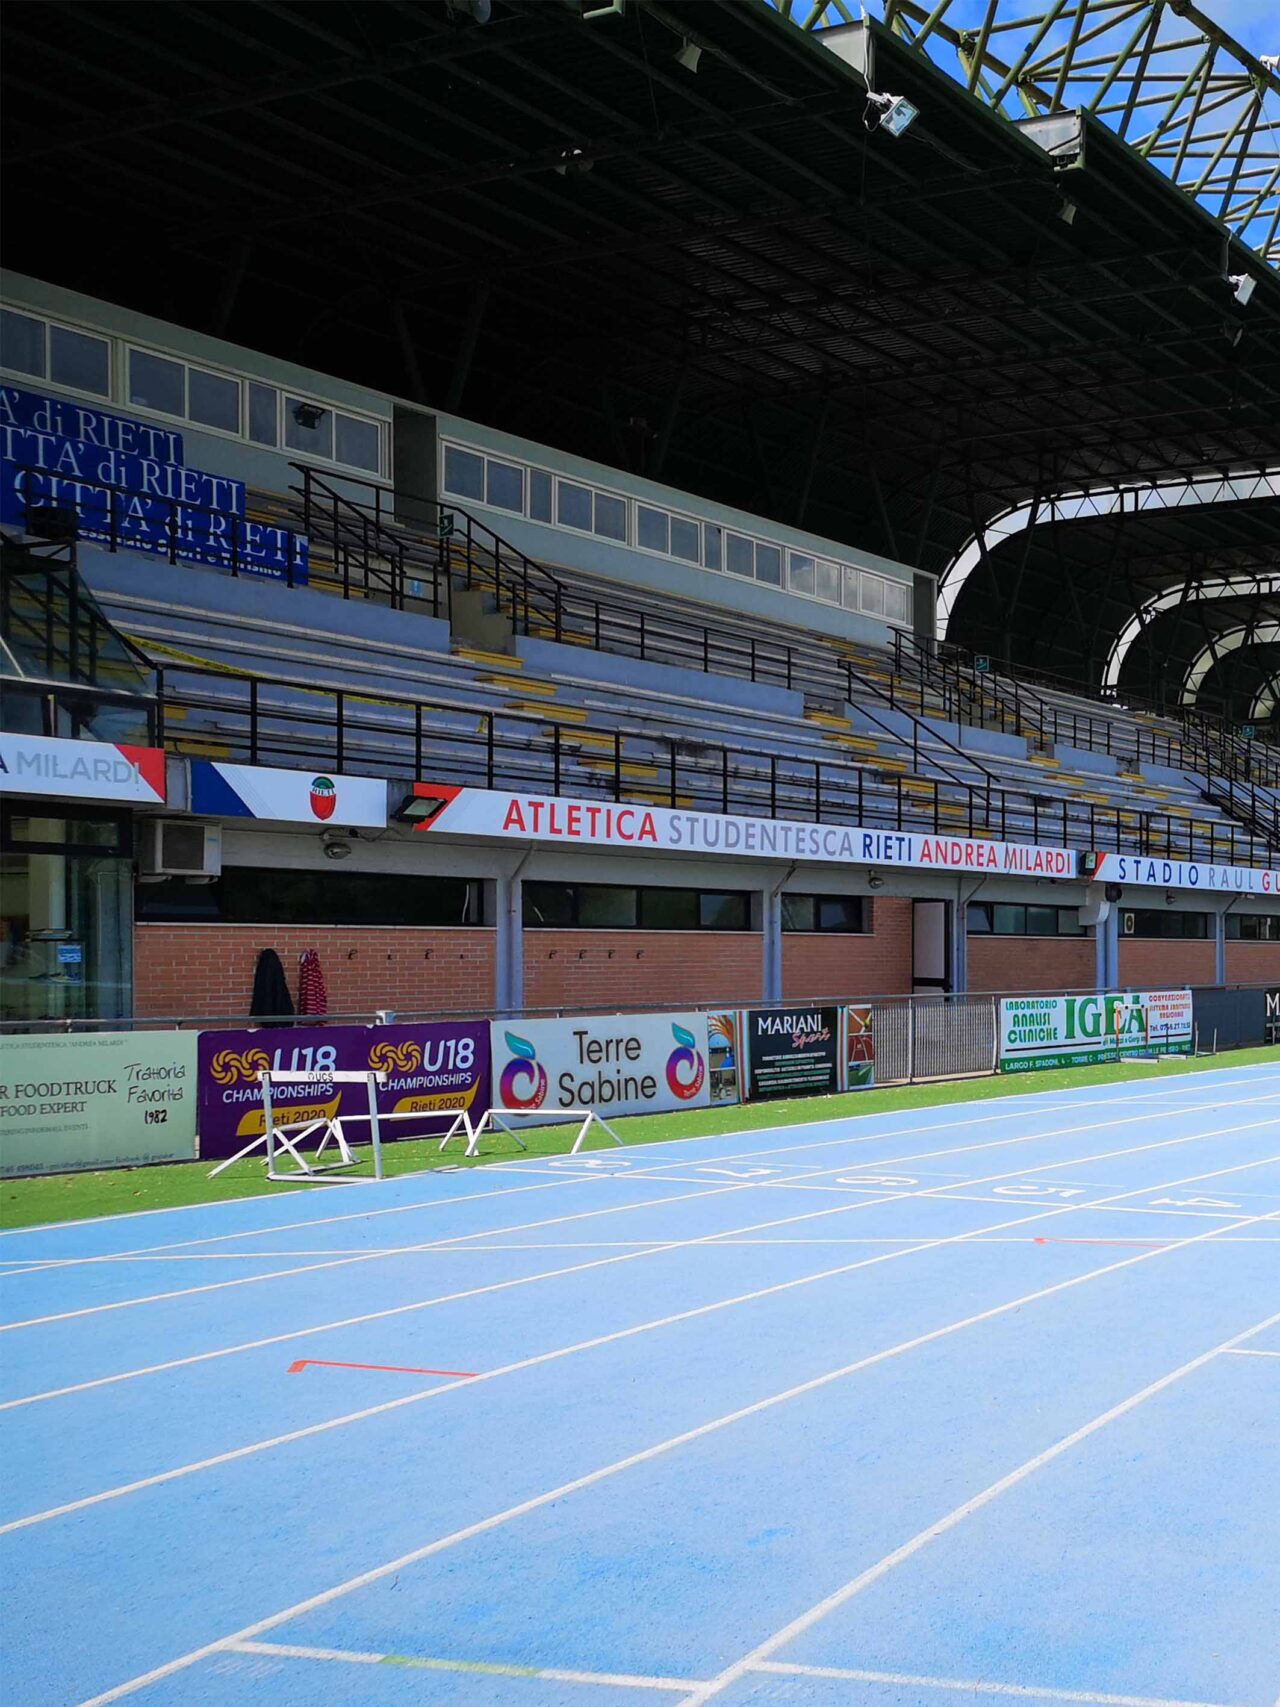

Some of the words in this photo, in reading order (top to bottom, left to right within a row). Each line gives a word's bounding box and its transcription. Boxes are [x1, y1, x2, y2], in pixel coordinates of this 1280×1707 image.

[33, 400, 63, 436] di
[76, 409, 178, 465] RIETI
[97, 451, 128, 488] di
[139, 460, 240, 516] RIETI
[165, 504, 194, 543] di
[205, 513, 308, 566] RETI
[16, 752, 140, 784] MILARDI
[502, 799, 658, 842] ATLETICA
[669, 815, 853, 857] STUDENTESCA
[863, 833, 912, 862] RIETI
[920, 839, 997, 868] ANDREA
[1003, 845, 1071, 874] MILARDI
[1119, 857, 1199, 886] STADIO
[1209, 866, 1253, 890] RAUL
[1006, 1000, 1057, 1010] LABORATORIO
[758, 1014, 821, 1035] MARIANI
[1013, 1013, 1050, 1027] ANALISI
[1065, 995, 1146, 1039] IGEA
[1007, 1028, 1058, 1044] CLINICHE
[423, 1037, 474, 1072] U18
[573, 1030, 641, 1065] Terre
[273, 1045, 336, 1073] U18
[124, 1061, 185, 1081] Trattoria
[315, 1073, 333, 1082] UCS
[14, 1080, 117, 1099] FOODTRUCK
[379, 1072, 472, 1091] CHAMPIONSHIPS
[558, 1069, 656, 1108] Sabine
[127, 1084, 183, 1103] Favorita
[223, 1083, 334, 1103] CHAMPIONSHIPS
[0, 1103, 37, 1117] FOOD
[40, 1101, 87, 1115] EXPERT
[410, 1098, 436, 1112] Rieti
[438, 1096, 465, 1109] 2020
[144, 1109, 168, 1124] 1982
[259, 1111, 290, 1127] Reti
[293, 1109, 326, 1124] 2020
[836, 1175, 918, 1186] 6
[993, 1185, 1086, 1198] 5
[1148, 1197, 1243, 1208] 4
